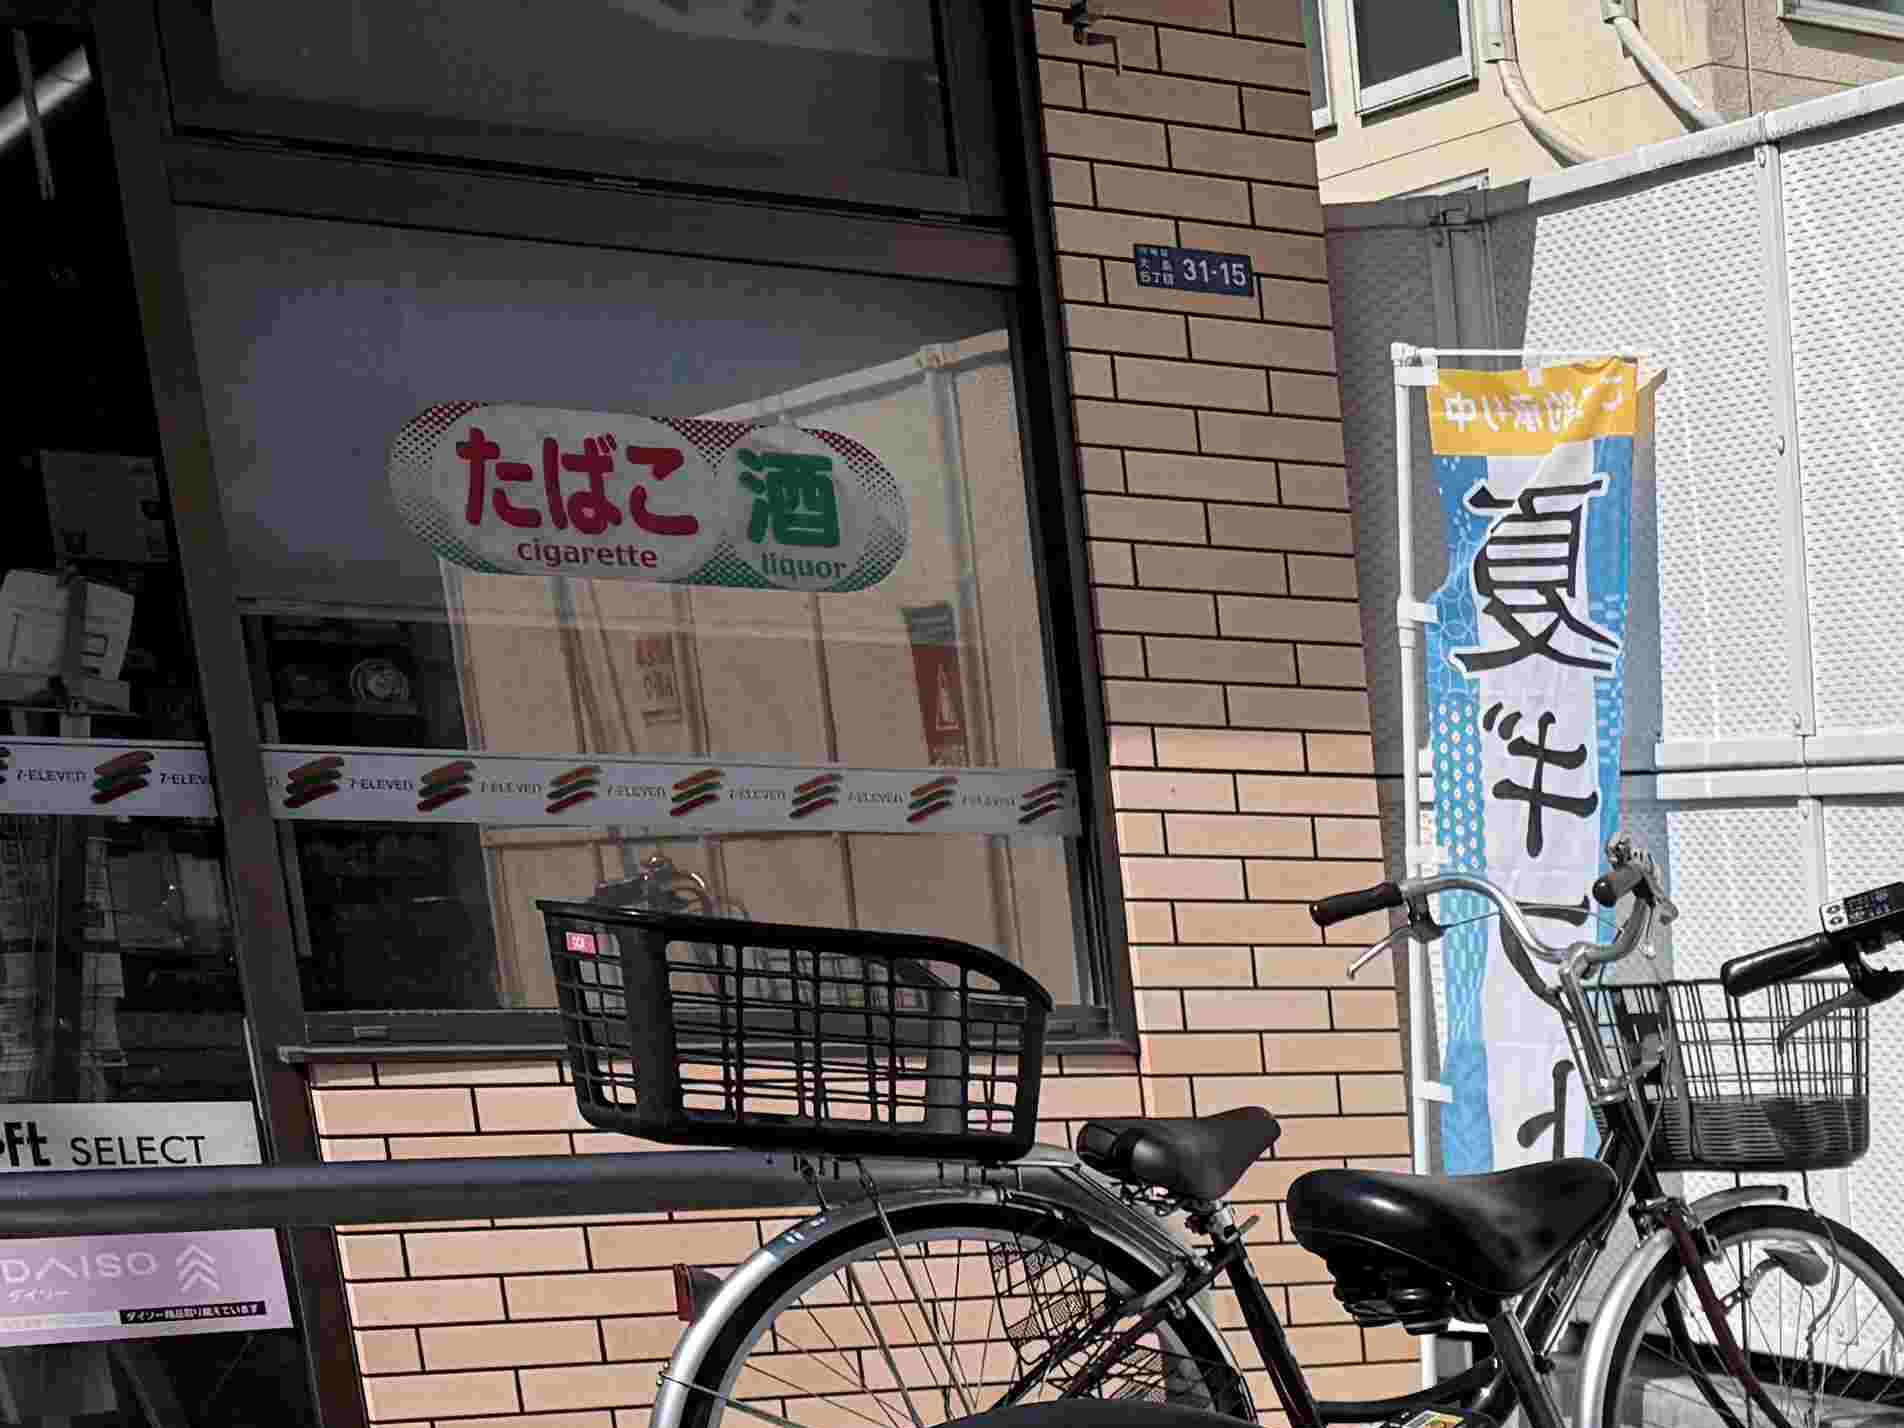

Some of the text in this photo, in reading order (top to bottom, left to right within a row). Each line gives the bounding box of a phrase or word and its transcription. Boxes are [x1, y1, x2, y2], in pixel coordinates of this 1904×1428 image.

[1183, 257, 1247, 286] 31-15
[455, 426, 699, 536] たばこ
[736, 447, 841, 548] 酒
[516, 537, 659, 568] cigarette
[760, 552, 848, 581] liquor
[70, 1135, 205, 1166] SELECT
[1, 1251, 158, 1283] DAISO
